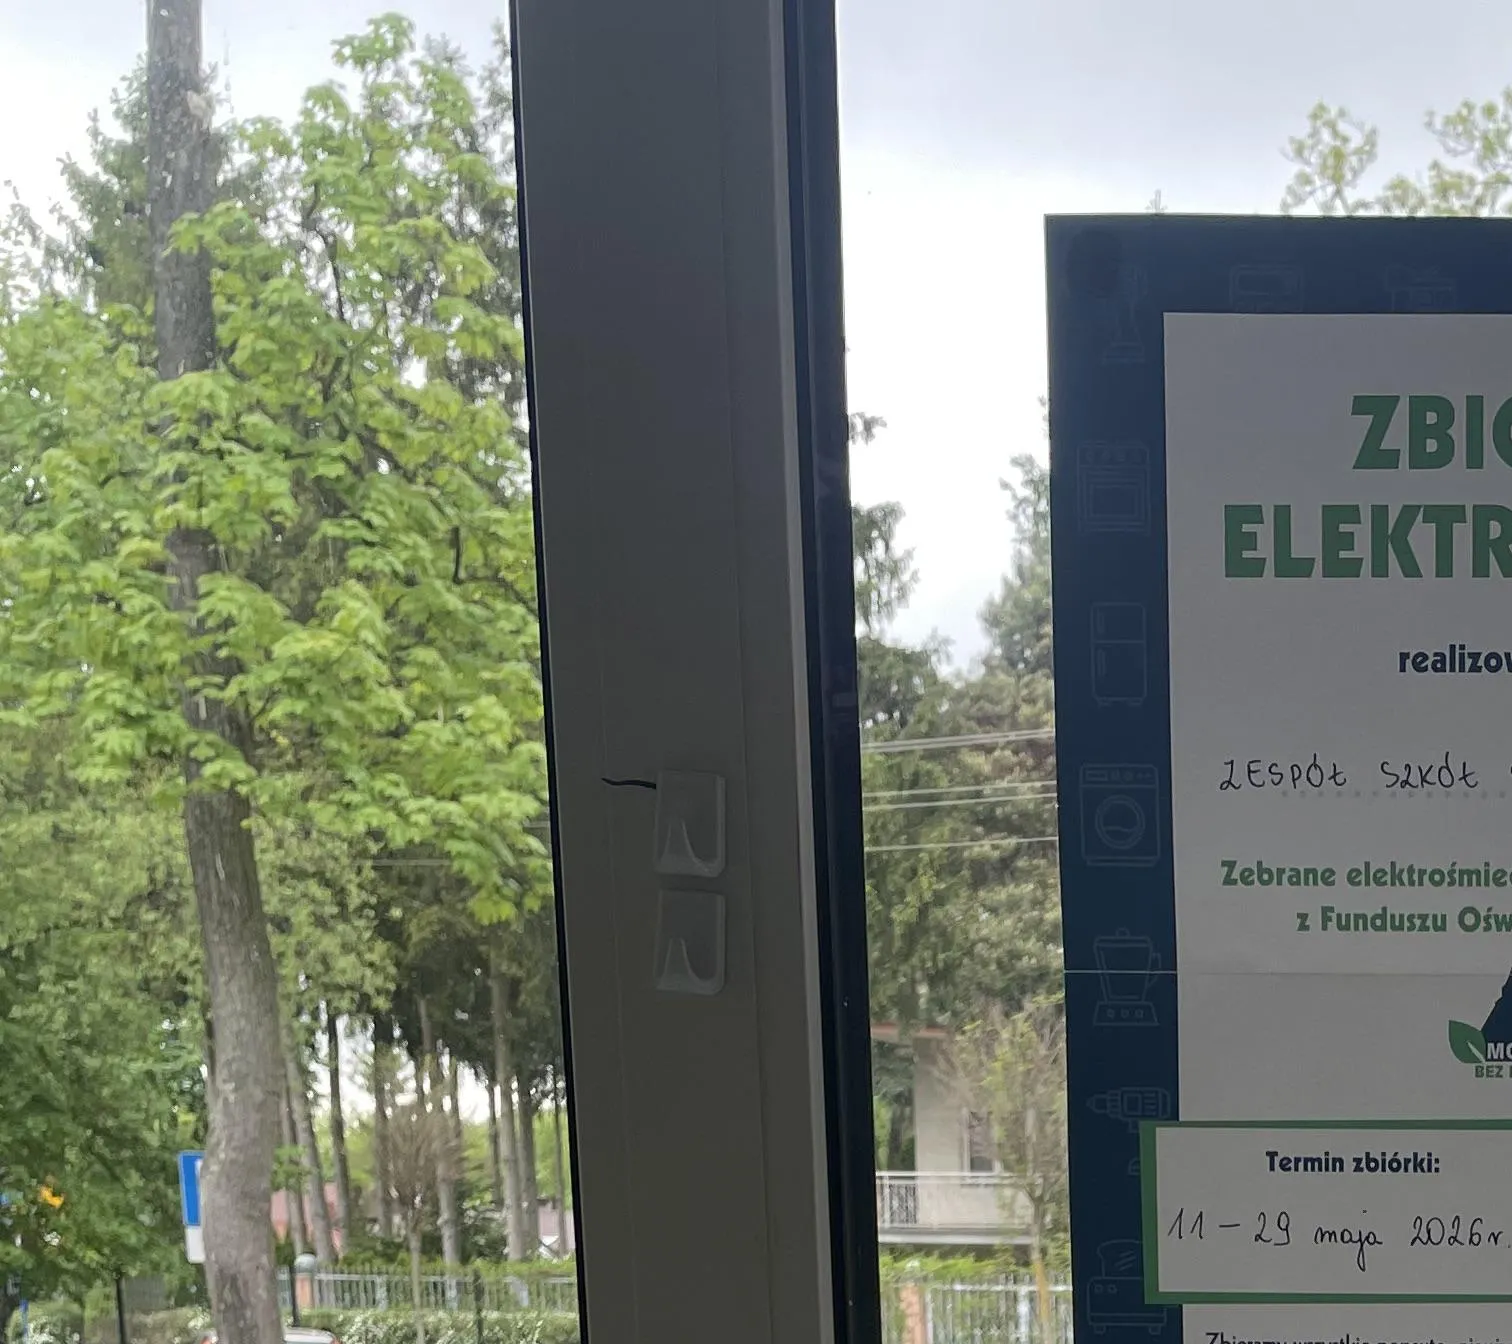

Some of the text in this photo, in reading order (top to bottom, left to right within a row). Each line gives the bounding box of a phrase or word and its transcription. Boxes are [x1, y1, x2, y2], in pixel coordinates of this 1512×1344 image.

[1219, 753, 1347, 791] ZESPÓŁ
[1380, 751, 1479, 789] SZKÓŁ
[1220, 859, 1337, 887] Zebrane
[1296, 912, 1311, 932] z
[1320, 905, 1448, 933] Funduszu
[1474, 1063, 1505, 1079] BEZ
[1265, 1150, 1440, 1174] Termin zbiórki:
[1167, 1207, 1205, 1240] 11
[1253, 1210, 1291, 1246] 29
[1314, 1208, 1383, 1272] maja
